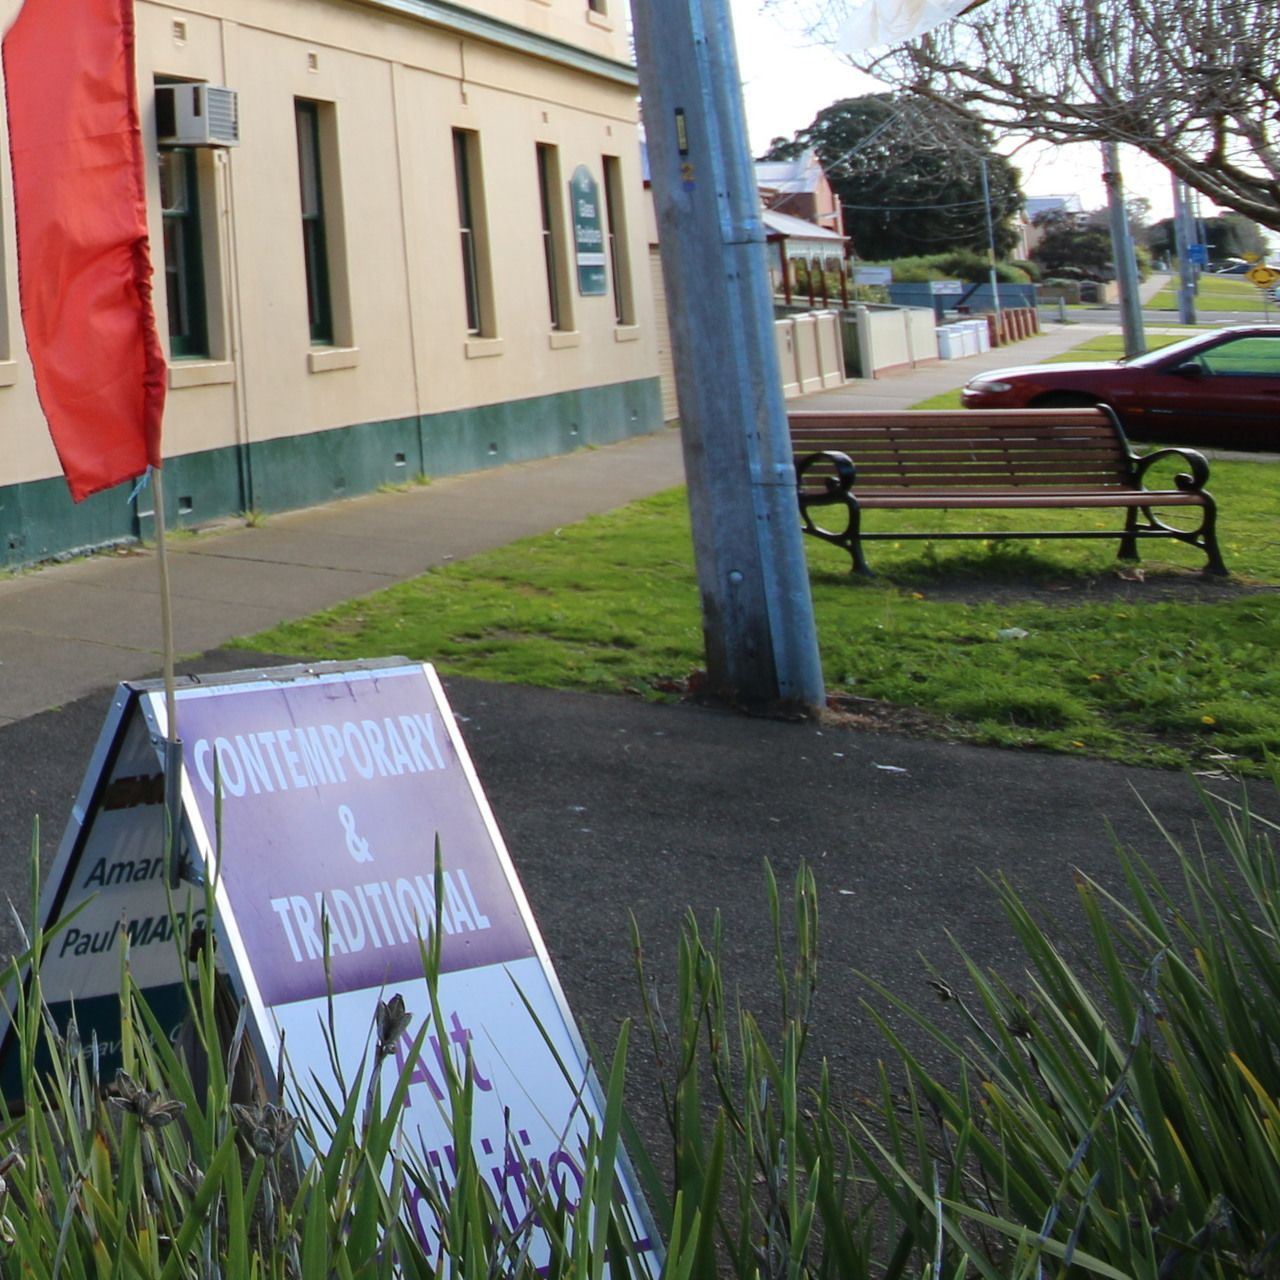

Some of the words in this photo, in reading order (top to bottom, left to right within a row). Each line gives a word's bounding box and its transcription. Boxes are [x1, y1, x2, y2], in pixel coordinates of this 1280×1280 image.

[193, 713, 446, 799] CONTEMPORARY
[338, 804, 375, 863] &
[59, 920, 121, 958] Paul
[271, 869, 491, 963] TRADITIONAL
